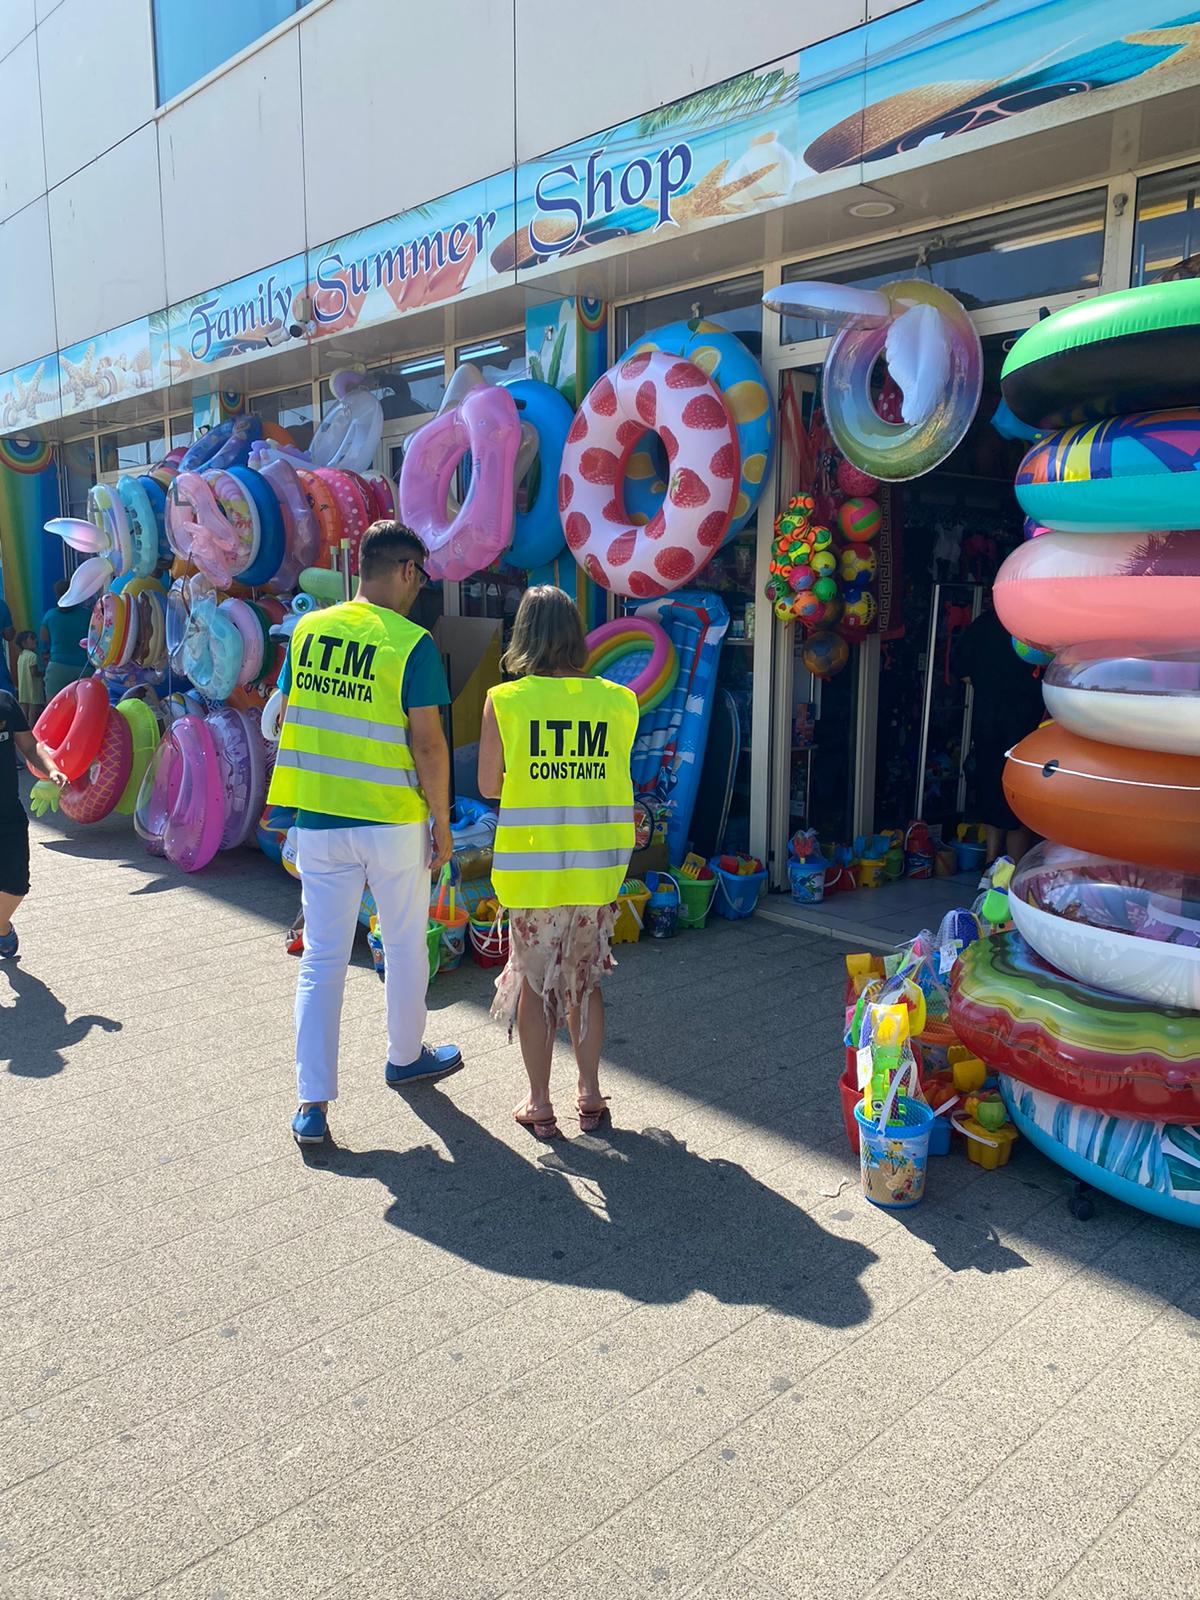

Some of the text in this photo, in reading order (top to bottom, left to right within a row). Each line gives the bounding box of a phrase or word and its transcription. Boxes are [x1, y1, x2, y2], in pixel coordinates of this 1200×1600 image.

[189, 142, 693, 361] Family Summer Shop
[298, 633, 376, 680] I.T.M.
[296, 672, 373, 703] CONSTANTA
[530, 720, 609, 757] I.T.M.
[530, 762, 607, 781] CONSTANTA
